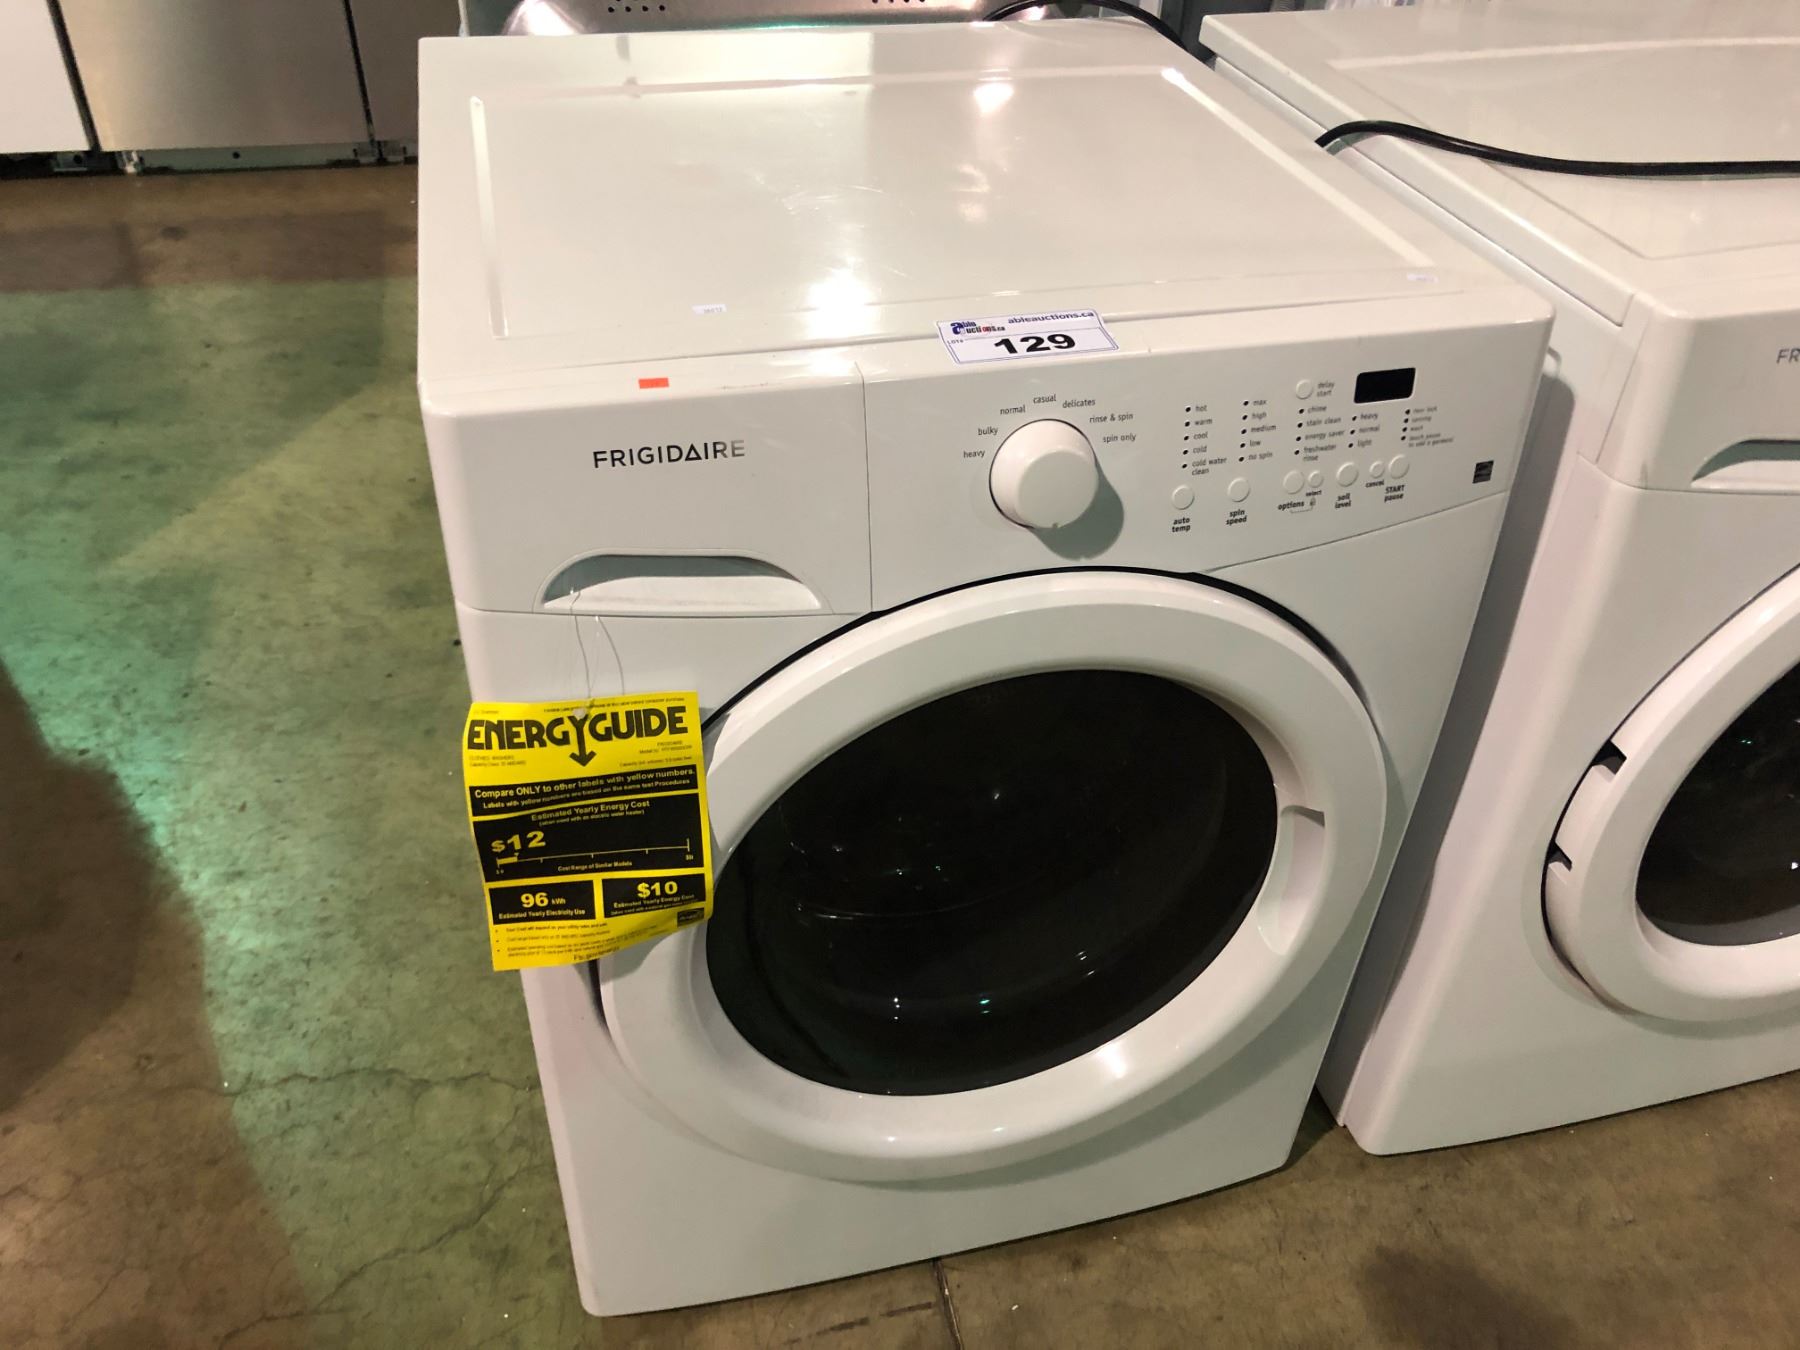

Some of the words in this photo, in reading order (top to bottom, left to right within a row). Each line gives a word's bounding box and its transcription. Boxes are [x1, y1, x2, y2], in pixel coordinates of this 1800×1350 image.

[1008, 311, 1094, 324] ableauctions.ca
[994, 333, 1076, 354] 129
[1318, 381, 1335, 389] delay
[1033, 394, 1057, 404] casual
[1062, 399, 1096, 409] delicates
[999, 405, 1026, 415] normal
[1089, 415, 1108, 423] rinse
[1109, 413, 1116, 421] &
[1117, 412, 1134, 422] spin
[1251, 412, 1267, 420] high
[1194, 418, 1213, 426] warm
[977, 427, 998, 436] bulky
[1193, 431, 1208, 440] cool
[1103, 433, 1118, 443] spin
[1121, 433, 1136, 443] only
[1192, 445, 1207, 453] cold
[592, 440, 745, 469] FRIGIDAIRE
[963, 450, 985, 459] heavy
[1191, 468, 1209, 476] clean
[1365, 479, 1385, 488] cancel
[1385, 485, 1405, 494] START
[1337, 493, 1351, 501] soil
[1384, 493, 1404, 503] pause
[1278, 500, 1305, 511] options
[1335, 500, 1352, 509] level
[1229, 509, 1245, 518] spin
[1173, 517, 1191, 525] auto
[1226, 515, 1247, 526] speed
[1172, 524, 1191, 533] temp
[474, 789, 515, 800] Compare
[516, 785, 541, 796] ONLY
[543, 784, 552, 792] to
[553, 782, 577, 791] other
[578, 778, 605, 788] labels
[606, 775, 625, 783] with
[626, 773, 654, 782] yellow
[531, 809, 572, 821] Estimated
[573, 805, 599, 815] Yearly
[600, 803, 630, 812] Energy
[637, 881, 678, 899] $10
[520, 892, 549, 908] 96
[551, 897, 566, 905] kWh
[498, 911, 527, 920] Estimated
[546, 908, 574, 916] Electricity
